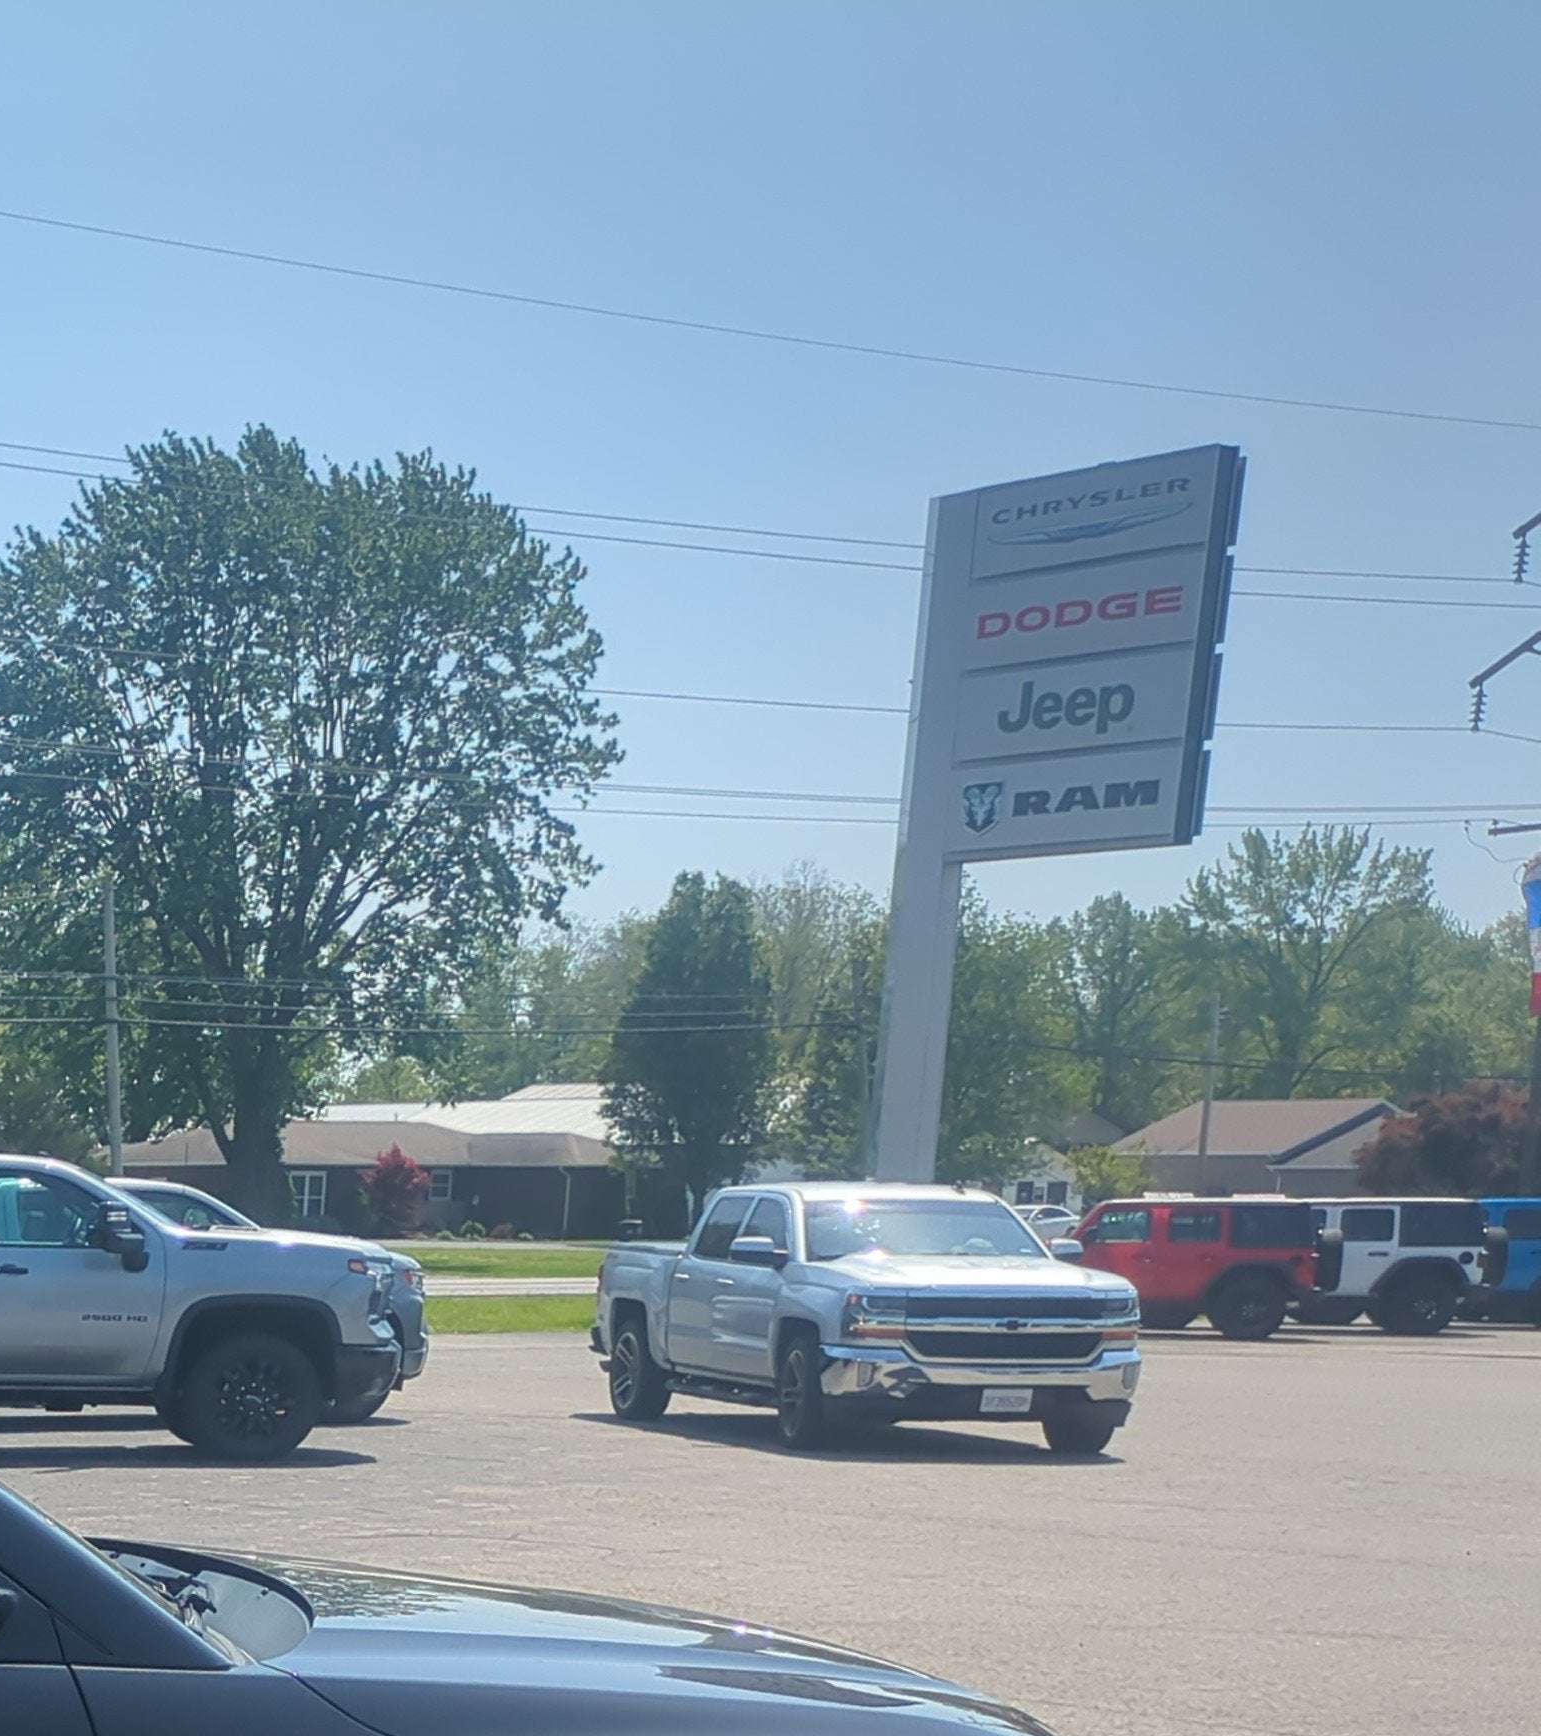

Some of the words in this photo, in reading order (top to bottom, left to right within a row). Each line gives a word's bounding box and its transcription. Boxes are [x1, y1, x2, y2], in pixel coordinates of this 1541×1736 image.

[991, 477, 1192, 525] CHRYSLER
[976, 585, 1184, 640] DODGE
[996, 680, 1135, 735] Jeep
[1012, 779, 1161, 817] RAM
